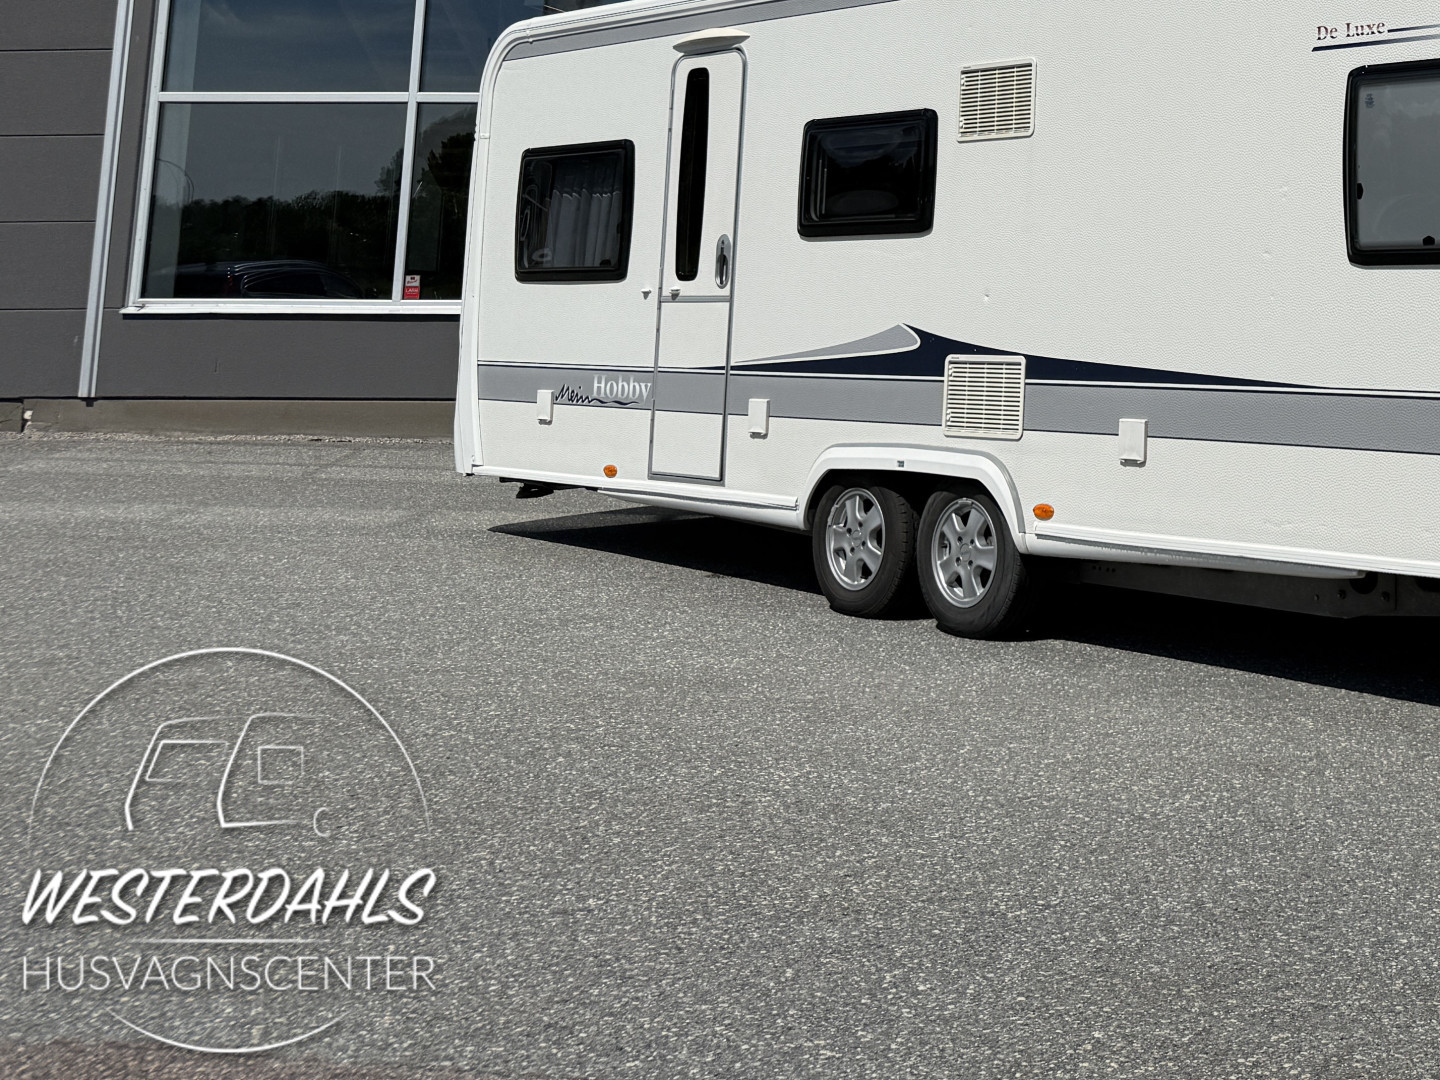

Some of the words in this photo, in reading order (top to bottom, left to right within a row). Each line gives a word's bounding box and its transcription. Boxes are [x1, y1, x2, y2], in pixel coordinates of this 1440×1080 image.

[1316, 25, 1338, 41] De
[1345, 22, 1386, 38] Luxe
[592, 373, 652, 403] Hobby
